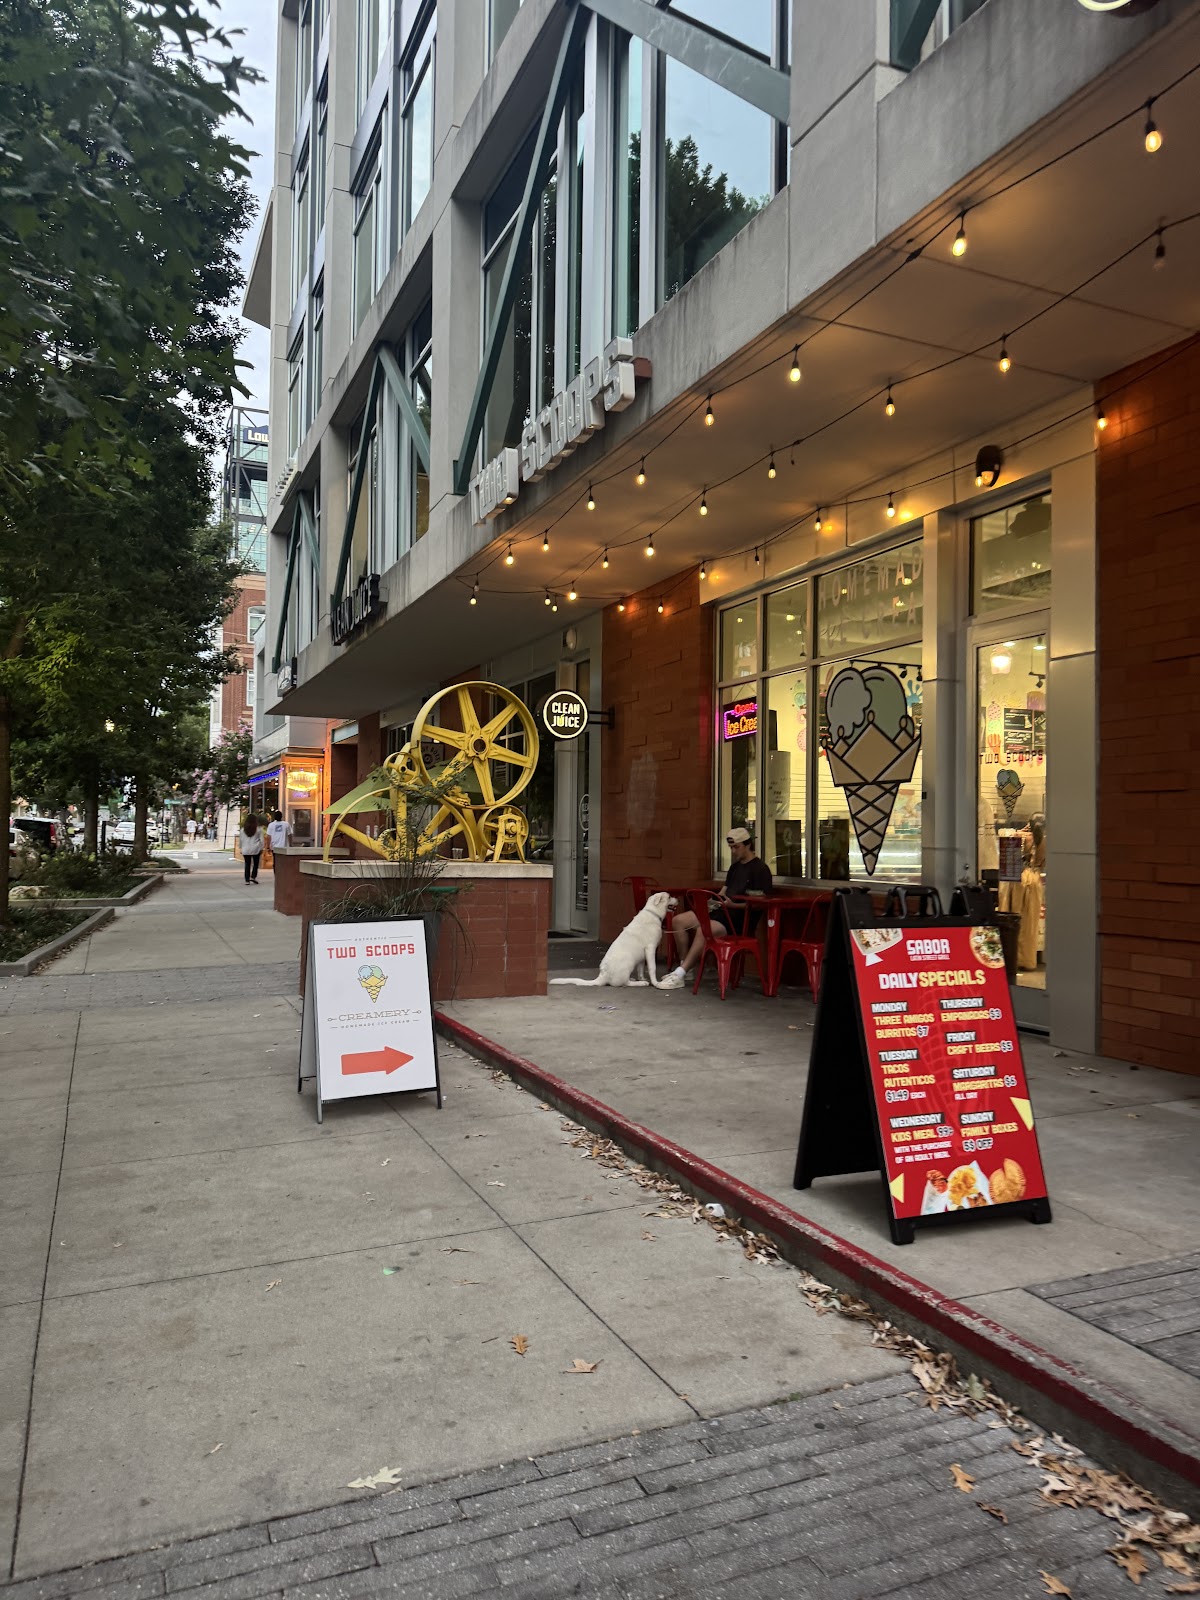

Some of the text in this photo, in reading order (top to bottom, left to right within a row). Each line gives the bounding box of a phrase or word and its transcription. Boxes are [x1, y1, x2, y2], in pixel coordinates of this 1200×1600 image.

[469, 336, 635, 526] TWO SCOOPS
[551, 702, 580, 714] CLEAN
[551, 714, 580, 728] JUICE
[727, 719, 740, 736] Ice
[979, 749, 1043, 765] TWO SCOOPS
[327, 943, 415, 959] TWO SCOOPS
[906, 938, 951, 955] SABOR
[879, 970, 986, 989] DAILY SPECIALS
[872, 1002, 907, 1013] MONDAY
[940, 998, 984, 1009] THURSDAY
[338, 1009, 411, 1022] CREAMERY
[873, 1013, 935, 1026] THREE AMIGOS
[940, 1008, 1002, 1022] EMPANADAS $3
[875, 1025, 929, 1039] BURRITOS $7
[946, 1032, 976, 1043] FRIDAY
[946, 1040, 1014, 1055] CRAFT BEERS $5
[879, 1049, 918, 1061] TUESDAY
[881, 1063, 910, 1074] TACOS
[952, 1066, 996, 1079] SATURDAY
[884, 1075, 936, 1088] AUTENTICOS
[953, 1075, 1018, 1091] MARGARITAS $6
[889, 1113, 942, 1128] WEDNESDAY
[960, 1111, 994, 1124] SUNDAY
[890, 1131, 912, 1142] KIDS
[912, 1128, 937, 1140] MEAL
[962, 1136, 994, 1152] 5$ OFF
